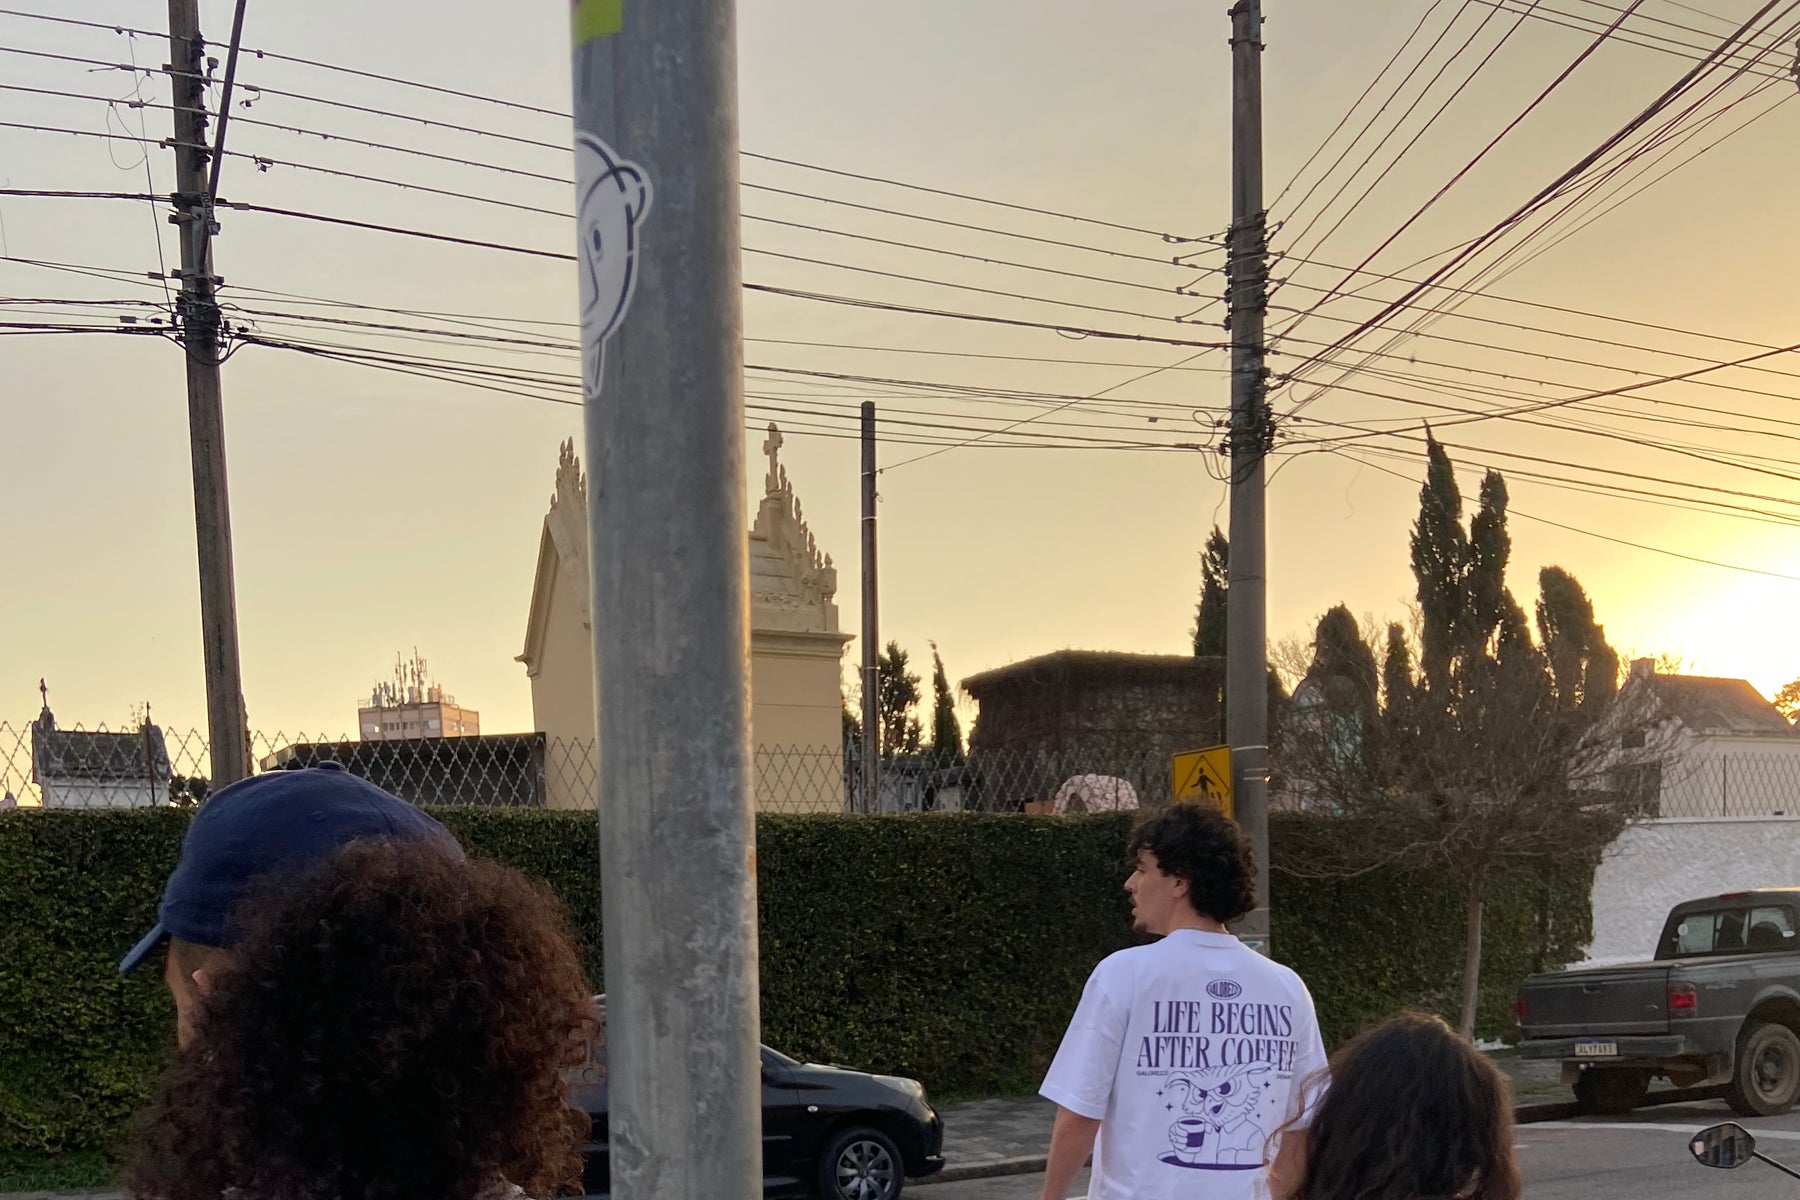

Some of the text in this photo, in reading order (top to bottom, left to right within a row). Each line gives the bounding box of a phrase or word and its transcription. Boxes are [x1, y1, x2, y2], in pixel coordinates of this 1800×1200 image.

[1153, 1001, 1292, 1037] LIFE BEGINS
[1136, 1036, 1299, 1071] AFTER COFFEE
